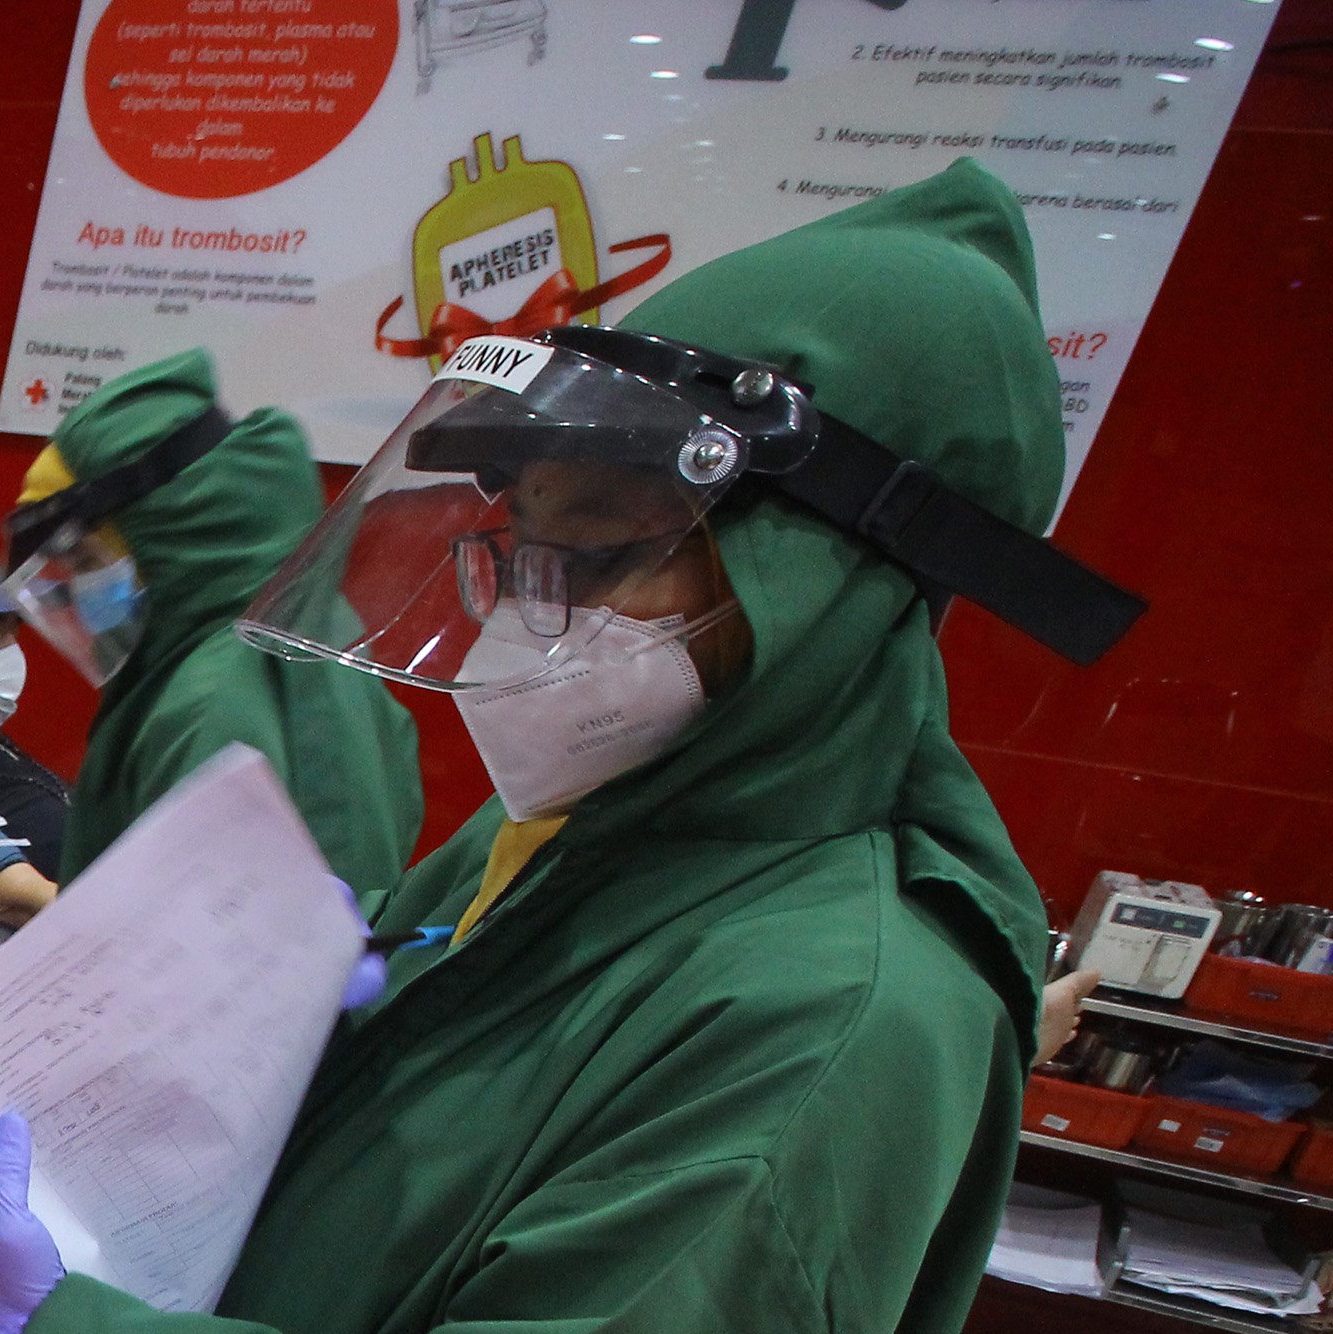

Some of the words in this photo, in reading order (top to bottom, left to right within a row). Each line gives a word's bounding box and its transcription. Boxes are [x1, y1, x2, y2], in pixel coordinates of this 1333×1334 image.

[275, 23, 333, 42] plasma
[337, 24, 376, 39] atau
[196, 46, 244, 63] darah
[871, 43, 937, 62] Efektif
[938, 48, 1056, 68] meningkatkan
[1057, 52, 1120, 69] jumlah
[1125, 53, 1216, 70] trombosit
[186, 70, 264, 90] komponen
[267, 73, 307, 92] yang
[312, 71, 355, 89] tidak
[915, 70, 971, 87] pasien
[973, 71, 1031, 86] secara
[833, 128, 928, 150] Mengurangi
[933, 132, 984, 148] reaksi
[990, 134, 1068, 151] transfusi
[1071, 139, 1115, 155] pada
[78, 221, 125, 249] Apa
[134, 224, 164, 247] itu
[171, 226, 307, 254] trombosit?
[449, 229, 555, 283] APHERESIS
[459, 250, 550, 298] PLATELET
[446, 344, 534, 378] FUNNY
[576, 709, 625, 734] KN95
